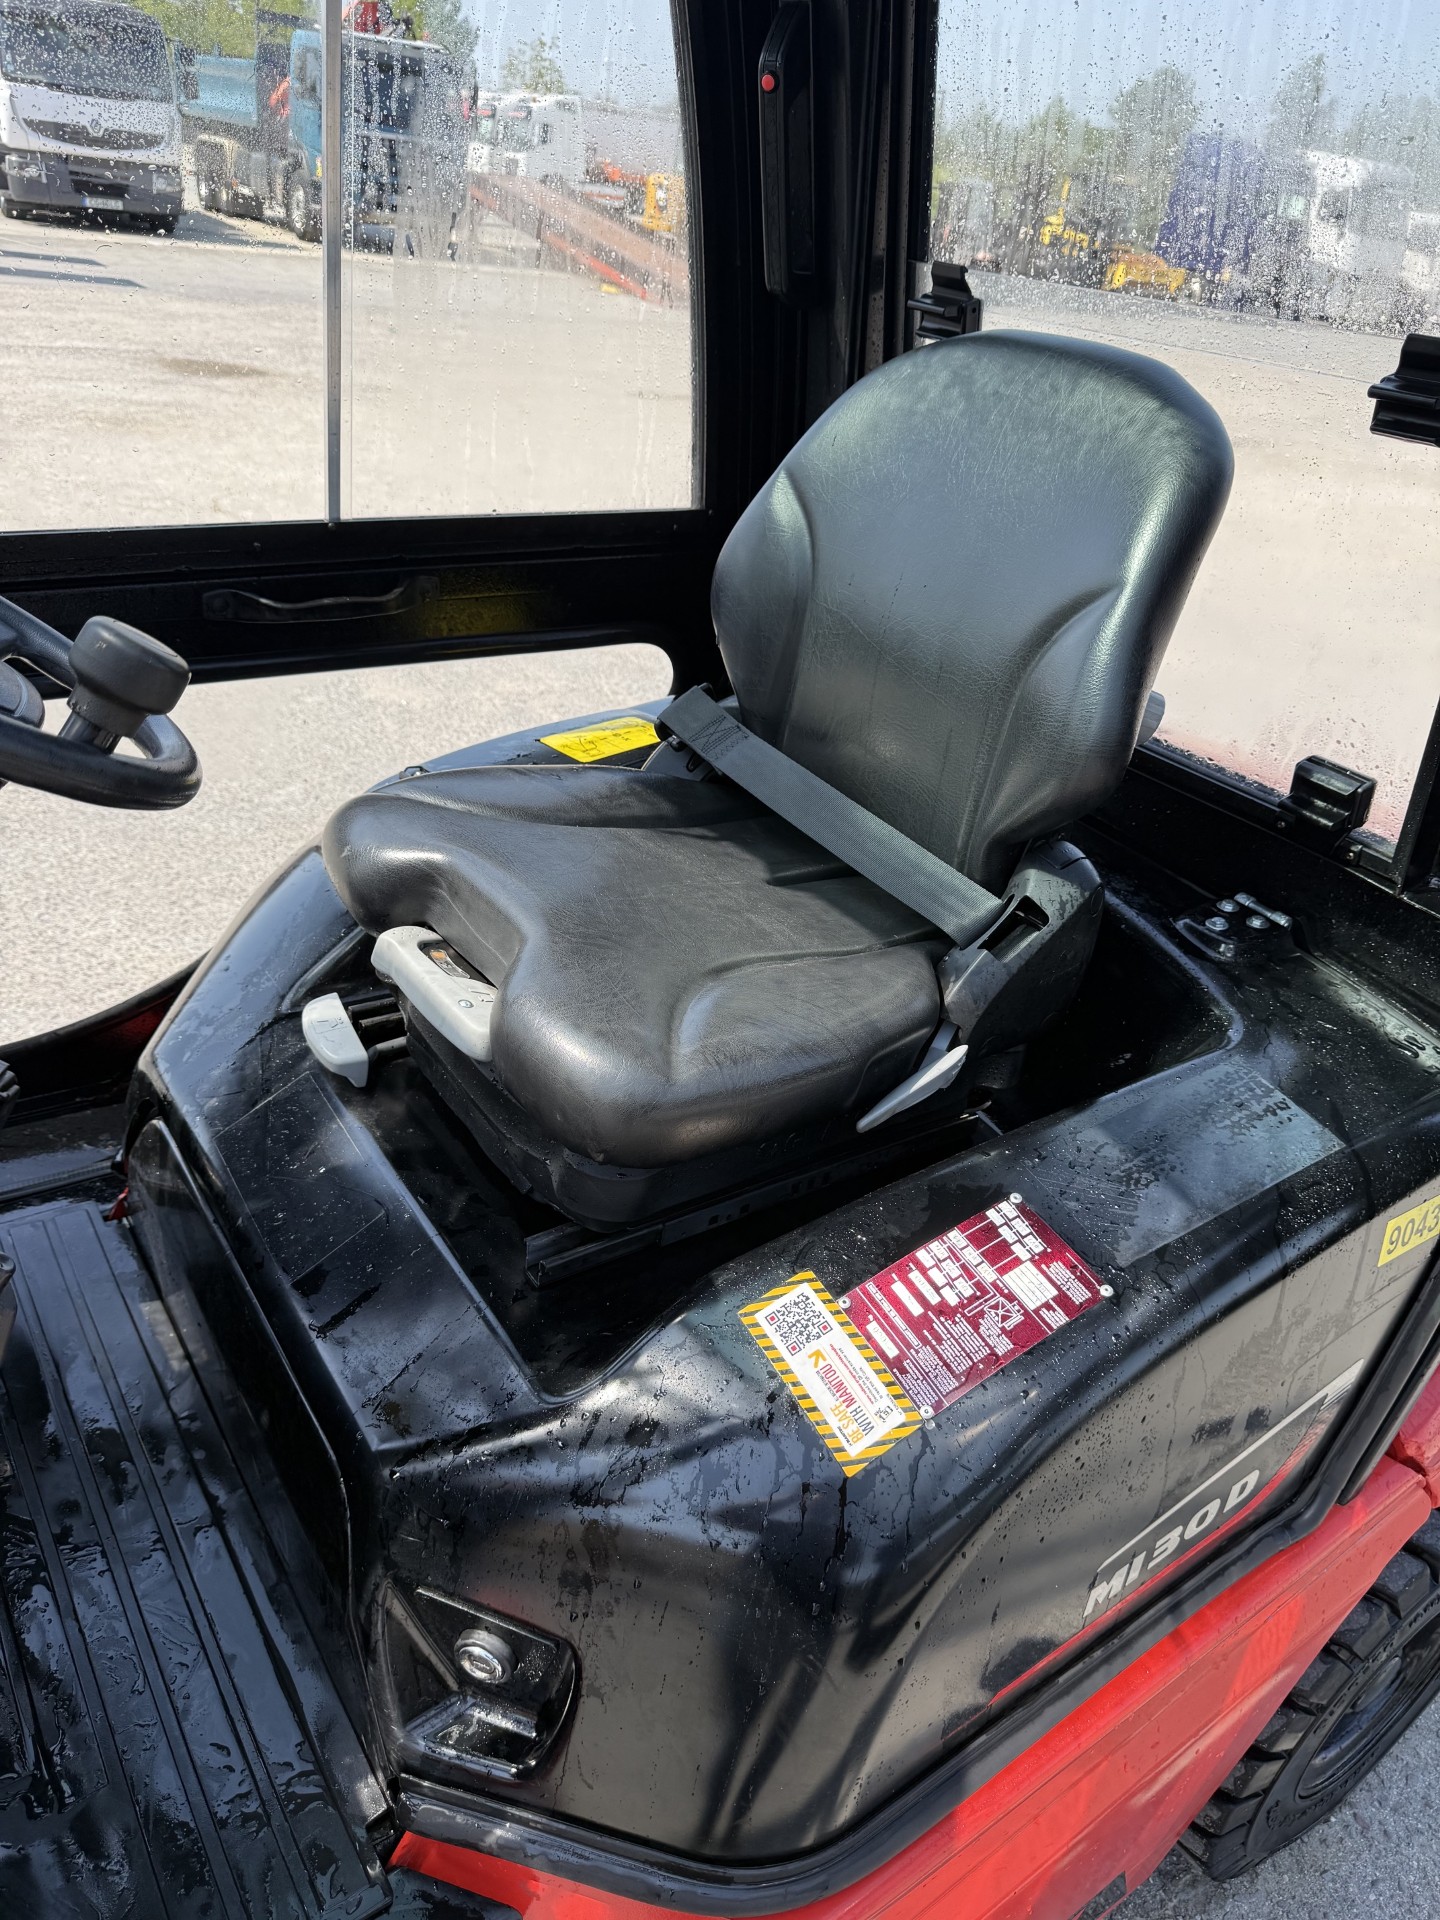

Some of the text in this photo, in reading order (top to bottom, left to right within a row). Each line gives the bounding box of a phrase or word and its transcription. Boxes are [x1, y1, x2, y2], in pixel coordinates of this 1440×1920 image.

[1386, 1203, 1440, 1255] 9043
[819, 1362, 857, 1408] MANITOU
[829, 1401, 855, 1430] SAFE
[849, 1405, 876, 1436] WITH
[846, 1425, 864, 1444] BE
